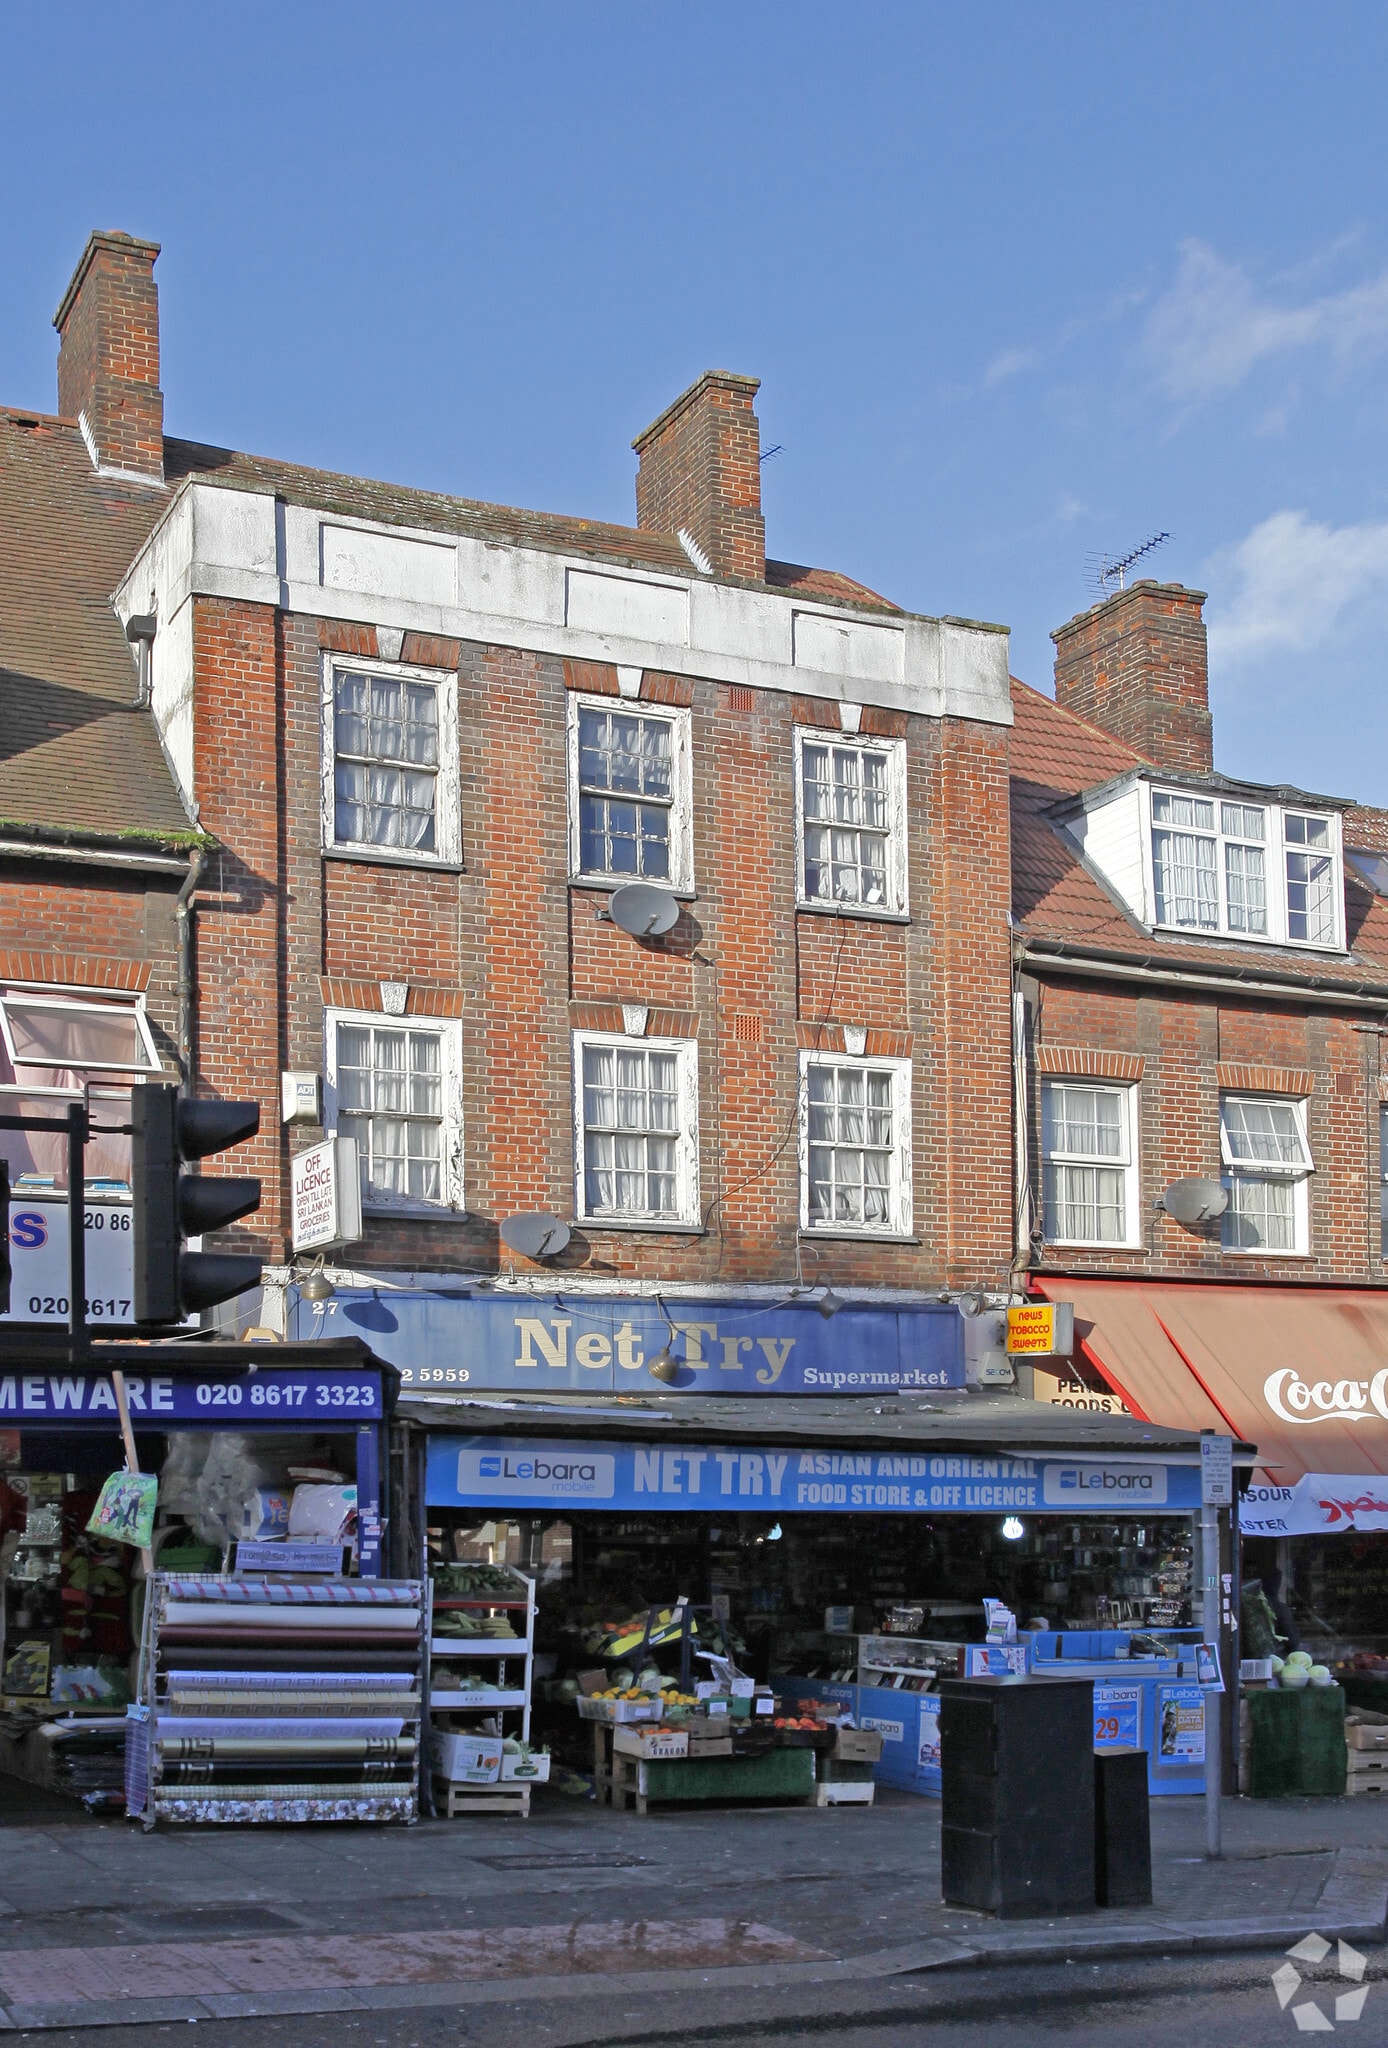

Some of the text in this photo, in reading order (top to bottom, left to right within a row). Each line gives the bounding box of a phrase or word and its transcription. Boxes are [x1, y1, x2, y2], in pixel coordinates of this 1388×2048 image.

[297, 1085, 314, 1096] ADT
[305, 1154, 321, 1173] OFF
[296, 1167, 331, 1195] LICENCE
[296, 1185, 332, 1207] OPEN TILL LATE
[297, 1197, 333, 1218] SRI LANKAN
[110, 1214, 133, 1231] 86
[300, 1211, 331, 1230] GROCERIES
[29, 1297, 69, 1315] 020
[312, 1302, 338, 1315] 27
[514, 1318, 796, 1385] Net Try
[419, 1368, 470, 1382] 5959
[803, 1367, 948, 1389] Supermarket
[196, 1384, 243, 1405] 020
[250, 1384, 308, 1405] 8617
[315, 1385, 375, 1406] 3323
[503, 1458, 595, 1481] Lebara
[634, 1449, 788, 1496] NET TRY
[798, 1454, 1038, 1479] ASIAN AND ORIENTAL
[551, 1481, 595, 1492] mobile
[1079, 1471, 1153, 1489] Lebara
[797, 1483, 1036, 1506] FOOD STORE & OFF LICENCE
[1117, 1491, 1152, 1499] mobile
[1101, 1690, 1138, 1701] Lebara
[1095, 1717, 1119, 1740] 29
